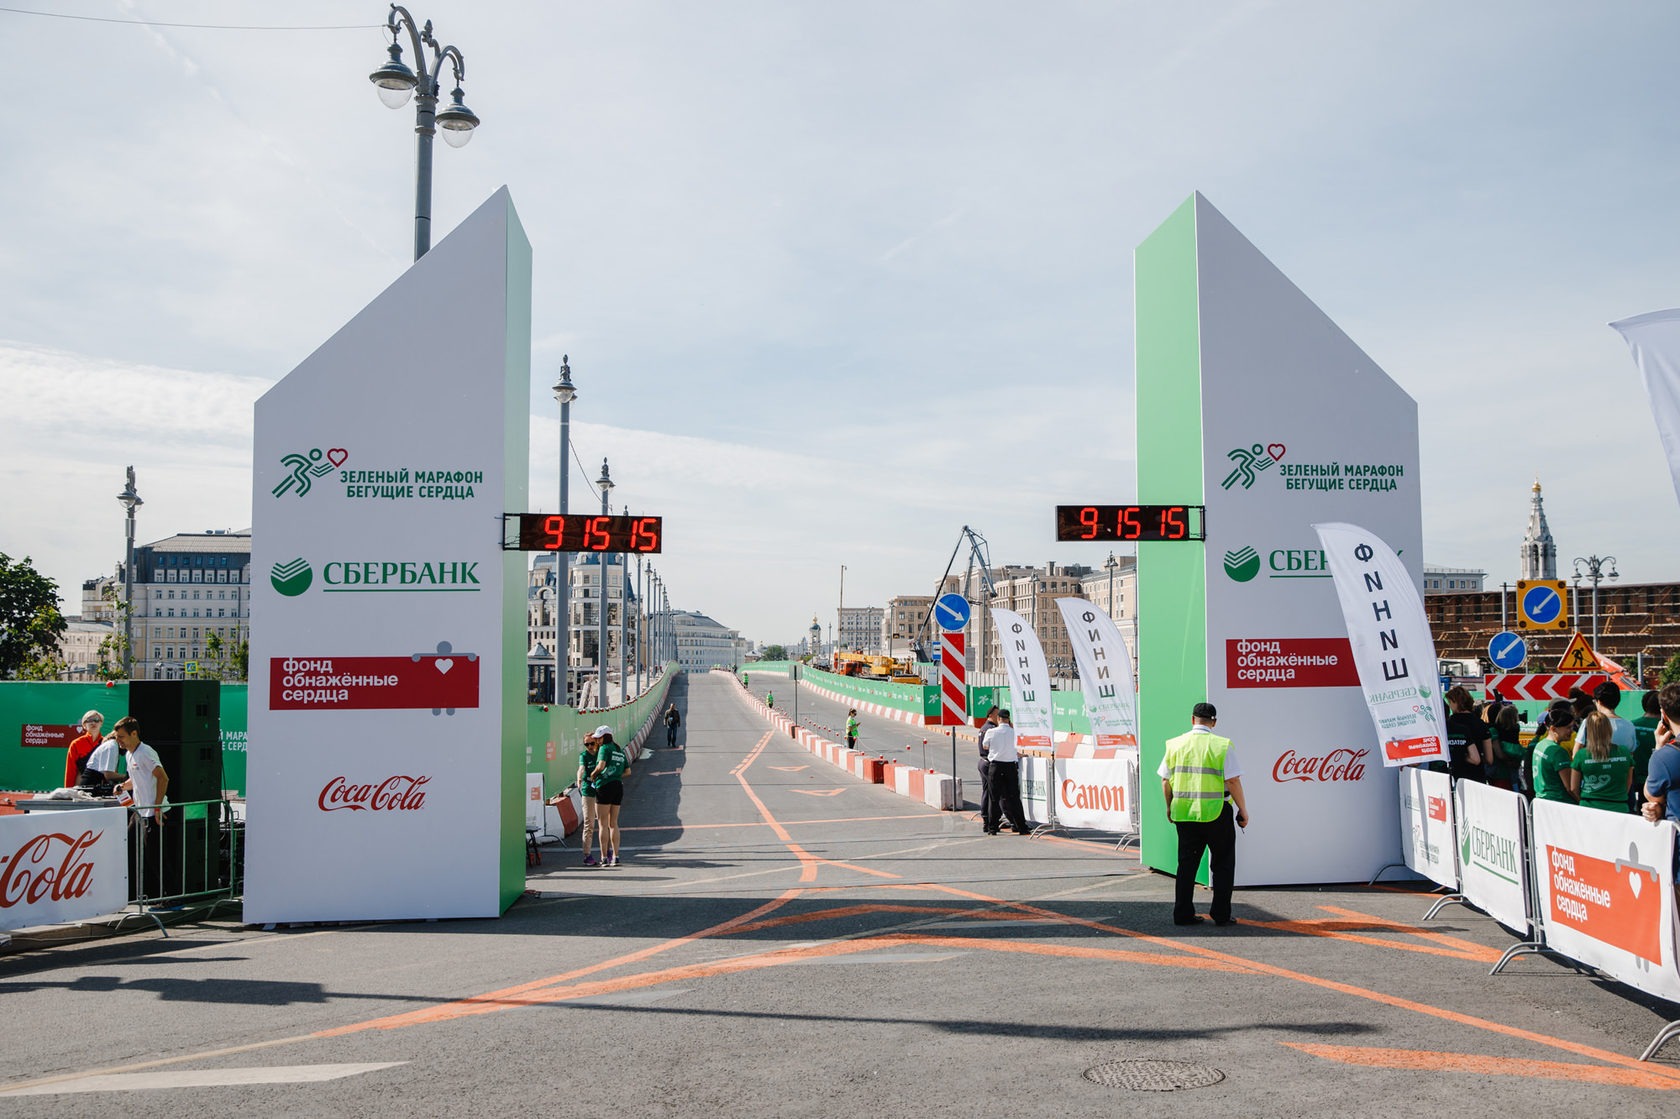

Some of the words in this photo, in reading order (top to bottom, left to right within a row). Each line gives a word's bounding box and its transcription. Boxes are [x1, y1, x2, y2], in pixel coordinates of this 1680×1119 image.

[340, 467, 409, 484] ЗЕЛЕНЫЙ
[414, 469, 483, 484] МАРАФОН
[1279, 462, 1339, 477] ЗЕЛЕНЫЙ
[1344, 464, 1404, 477] МАРАФОН
[346, 485, 413, 500] БЕГУЩИЕ
[418, 485, 475, 500] СЕРДЦА
[1286, 478, 1344, 492] БЕГУЩИЕ
[1348, 478, 1397, 492] СЕРДЦА
[544, 515, 565, 550] 9
[1079, 507, 1099, 539] 9
[323, 561, 480, 585] СБЕРБАНК
[1082, 611, 1116, 698] ФИНИШ
[1236, 639, 1281, 656] фонд
[282, 656, 333, 675] фонд
[1237, 653, 1338, 667] обнажённые
[282, 672, 399, 687] обнажённые
[1237, 667, 1296, 682] сердца
[282, 689, 349, 704] сердца
[226, 731, 249, 741] МАРА
[227, 741, 249, 753] СЕРД
[1272, 748, 1372, 783] Coca-Cola
[317, 775, 433, 812] Coca-Cola
[1061, 778, 1125, 812] Canon
[1471, 825, 1518, 875] СБЕРБАНК
[1551, 846, 1576, 876] фонд
[1553, 870, 1611, 908] обнажённые
[1556, 894, 1588, 923] сердца
